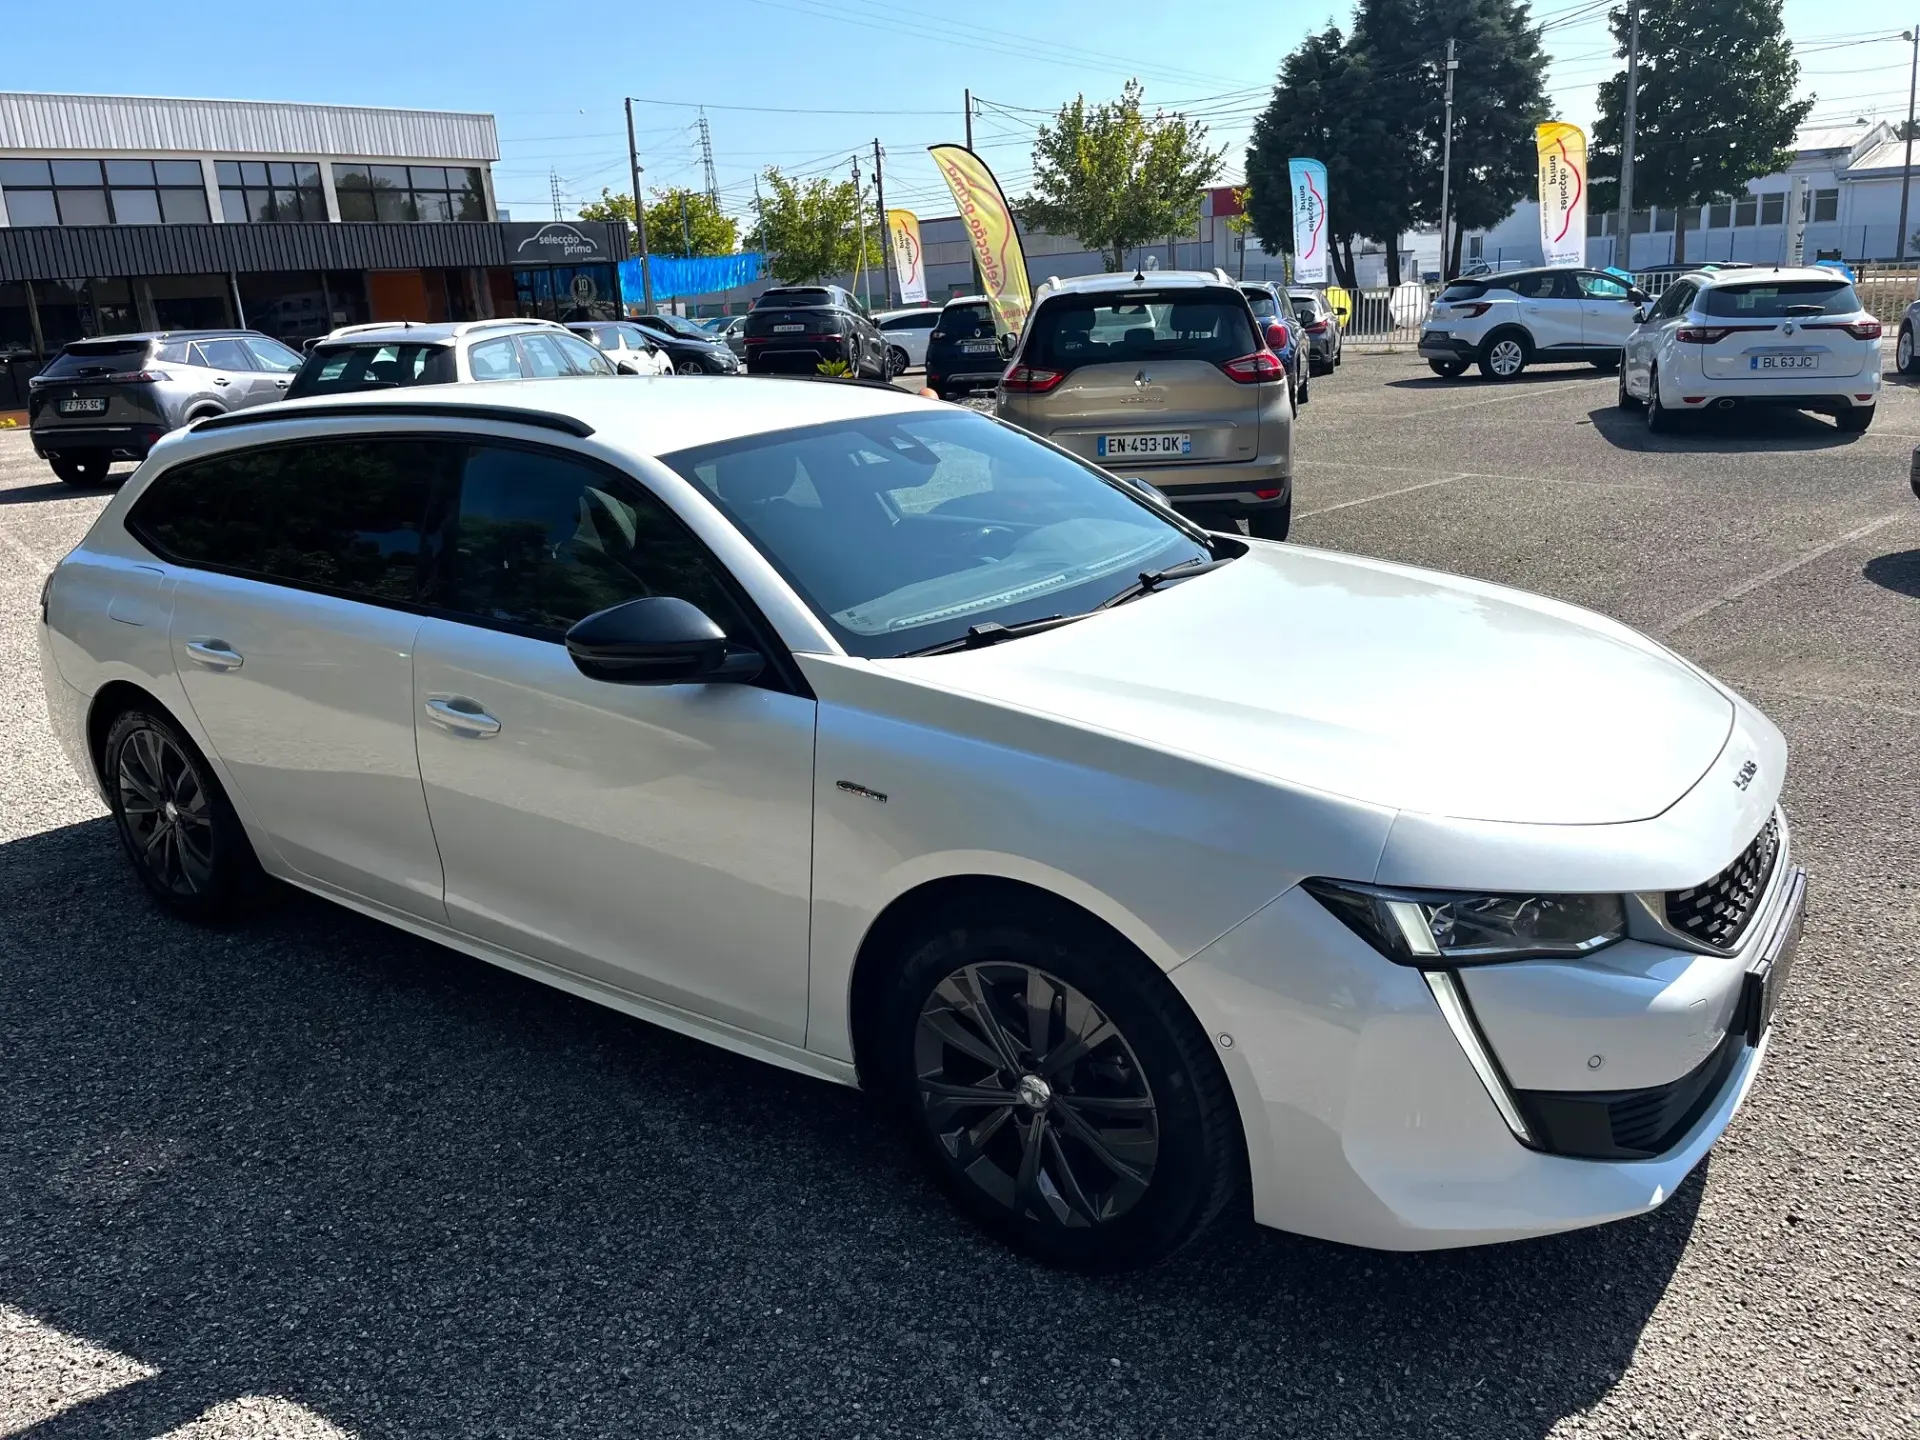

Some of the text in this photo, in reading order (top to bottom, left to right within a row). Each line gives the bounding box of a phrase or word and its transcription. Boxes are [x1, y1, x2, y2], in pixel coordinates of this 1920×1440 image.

[539, 234, 580, 246] selecção
[564, 244, 592, 256] prima
[1763, 356, 1812, 368] BL 63 JC
[1108, 436, 1180, 453] EN-493-QK
